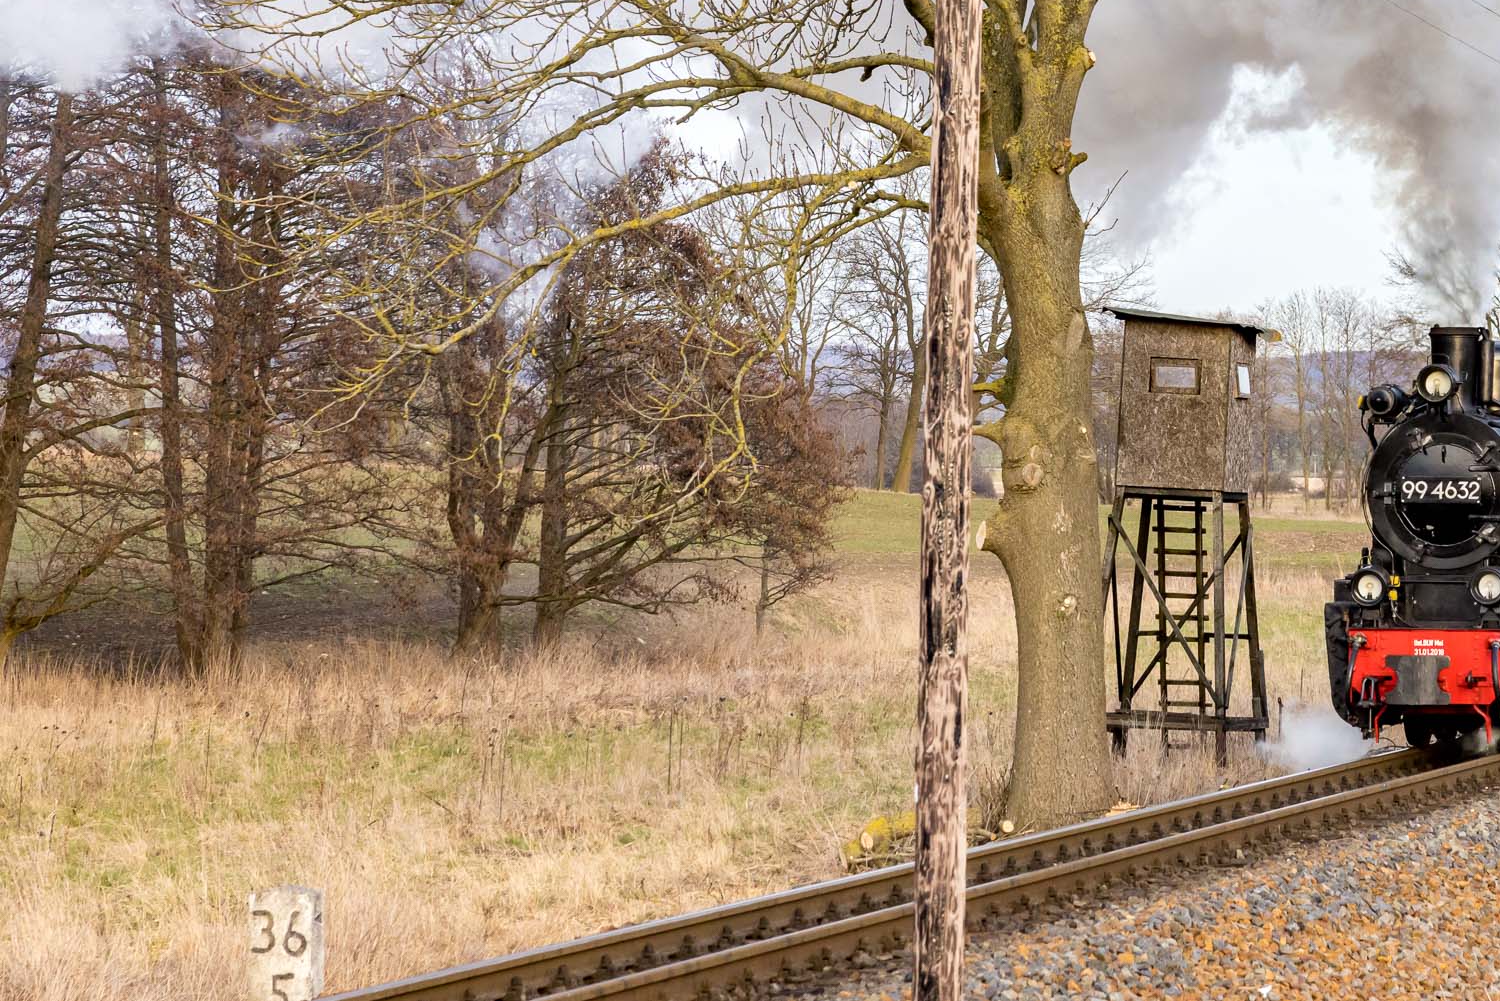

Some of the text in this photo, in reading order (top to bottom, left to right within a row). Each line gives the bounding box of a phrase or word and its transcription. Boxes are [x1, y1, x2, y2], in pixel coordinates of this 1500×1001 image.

[1402, 480, 1480, 500] 99 4632
[251, 909, 307, 958] 36
[272, 972, 295, 1001] 5
